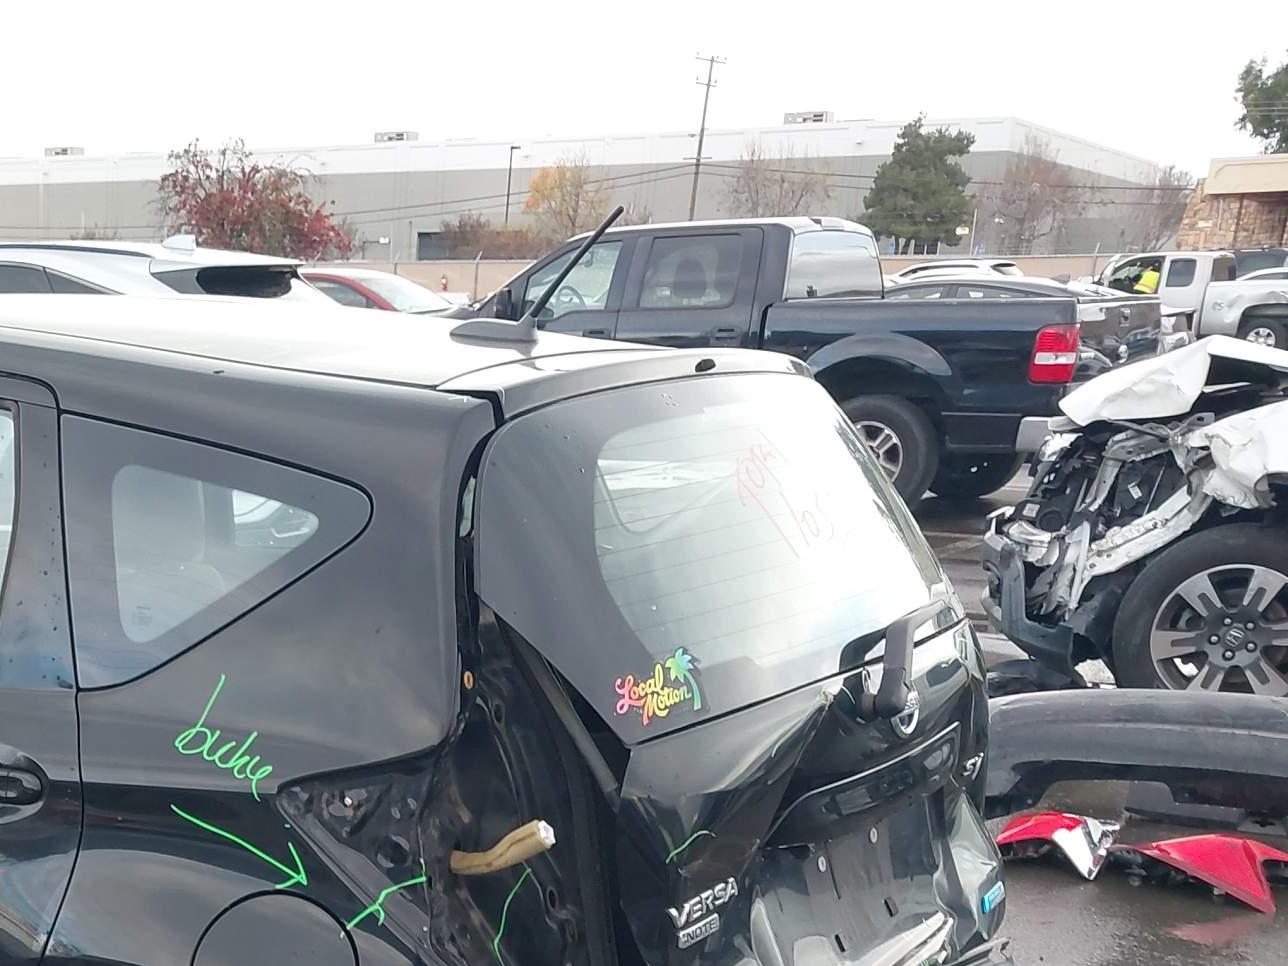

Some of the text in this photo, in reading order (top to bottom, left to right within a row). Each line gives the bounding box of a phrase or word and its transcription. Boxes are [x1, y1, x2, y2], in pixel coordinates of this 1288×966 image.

[615, 663, 665, 714] Local
[642, 684, 692, 726] Motion
[665, 876, 739, 929] VERSA
[685, 919, 718, 944] NOTE
